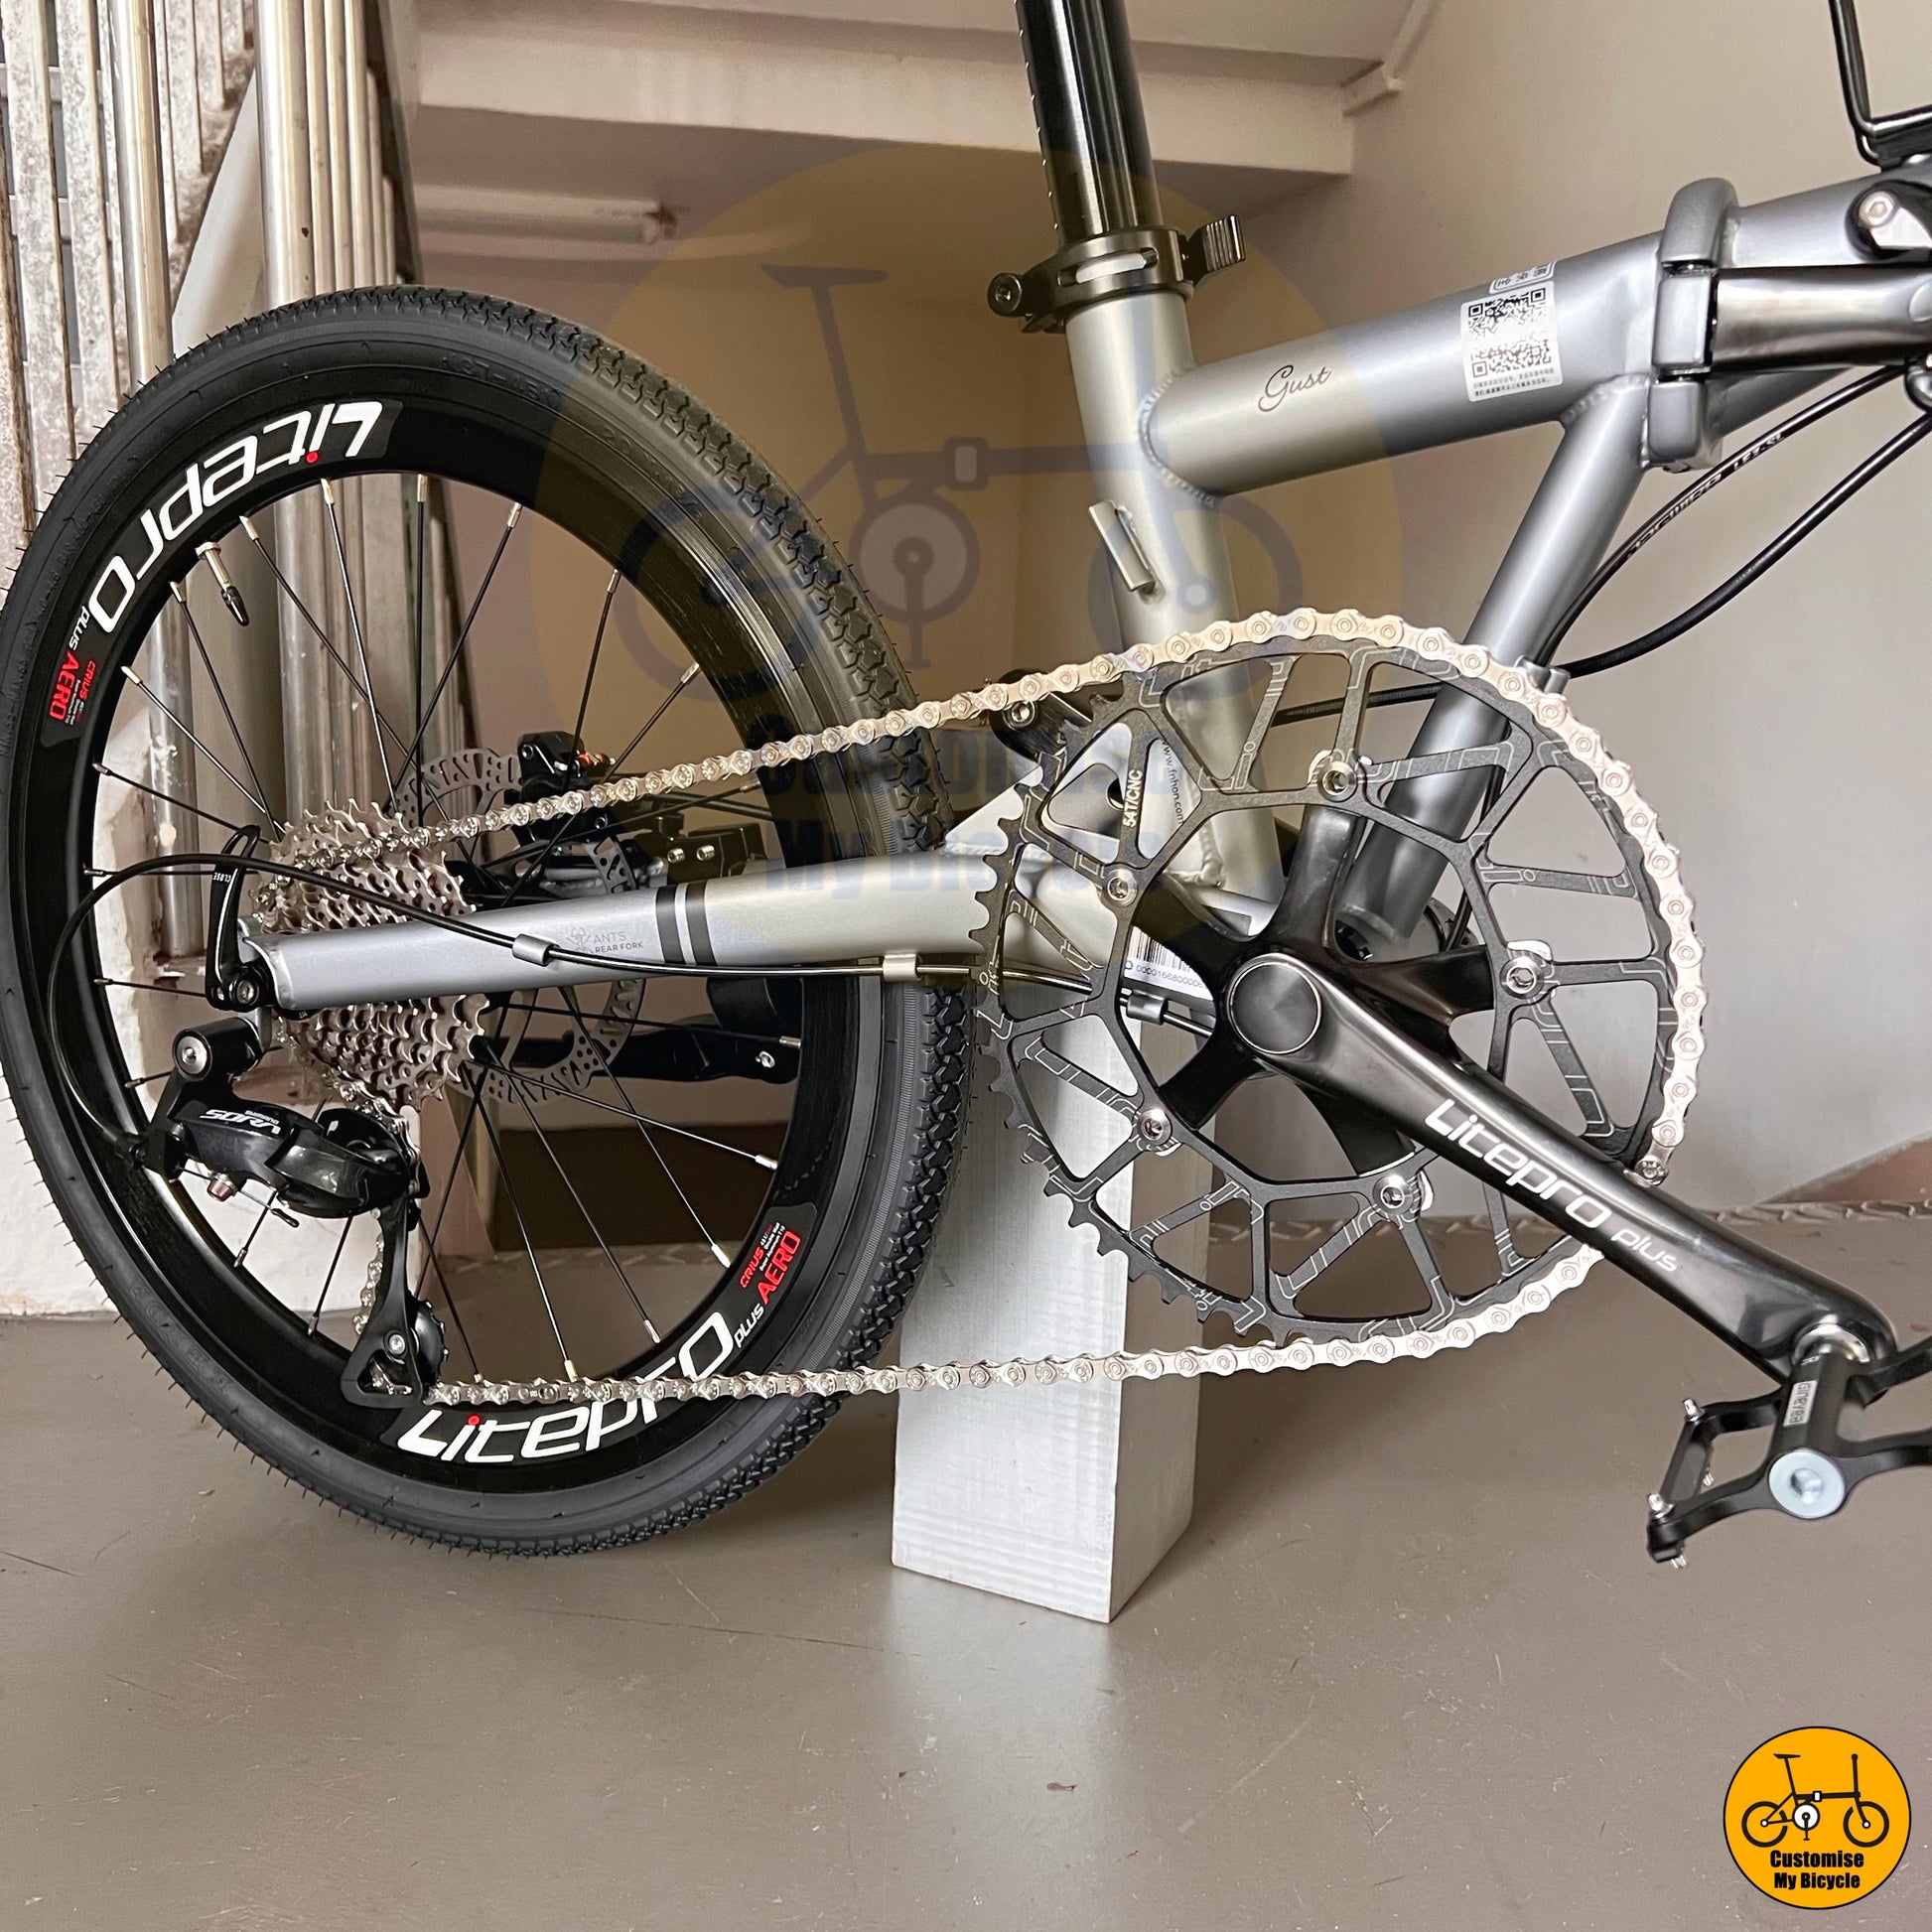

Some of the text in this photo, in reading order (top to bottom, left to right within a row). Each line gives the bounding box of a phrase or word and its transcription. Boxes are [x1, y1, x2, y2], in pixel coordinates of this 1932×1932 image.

[1258, 364, 1331, 412] Gust
[69, 400, 383, 651] Litepro plus
[49, 650, 79, 721] AERO
[79, 659, 96, 701] CRIUS
[592, 930, 626, 943] ANTS
[595, 941, 644, 954] REAR FORK
[1424, 1098, 1679, 1273] Litepro plus
[740, 1246, 764, 1288] CRIUS
[756, 1228, 803, 1305] AERO
[397, 1303, 765, 1463] Litepro plus
